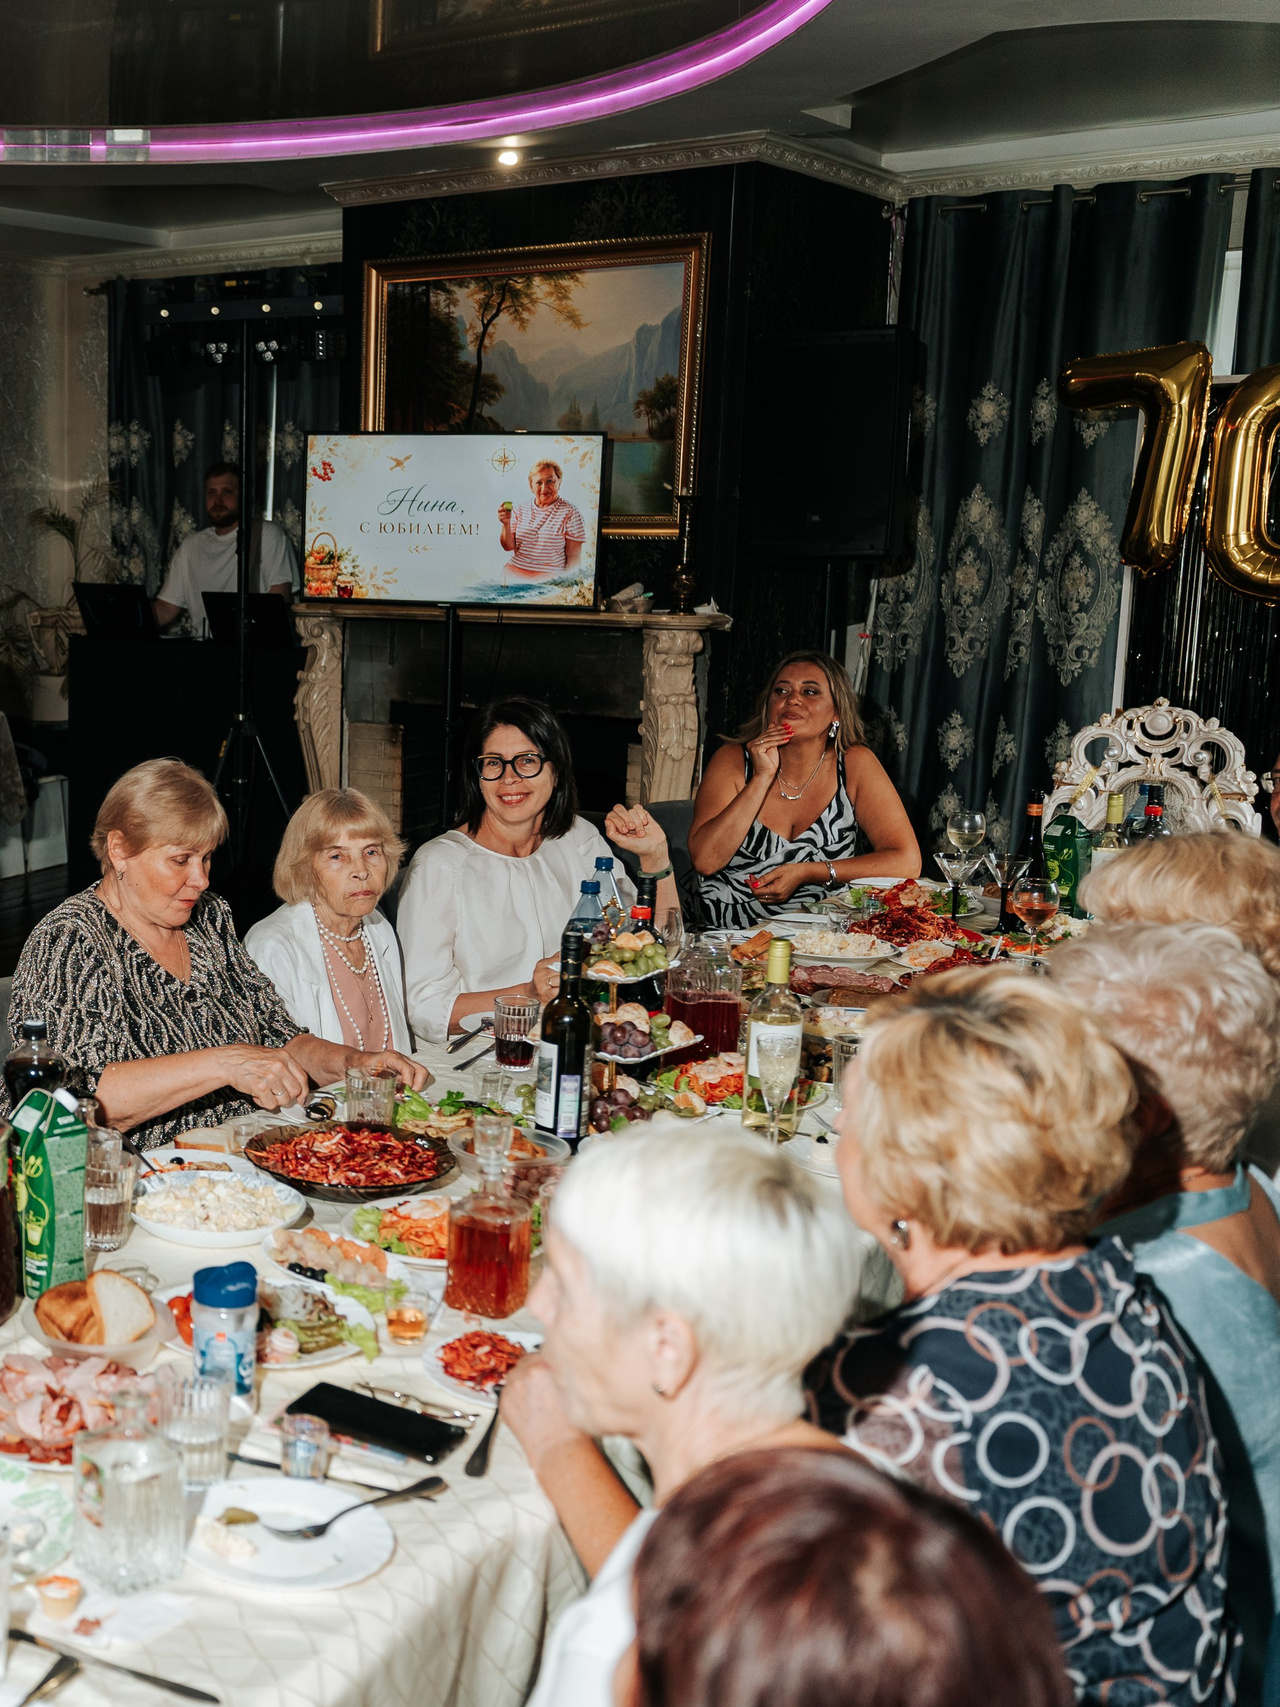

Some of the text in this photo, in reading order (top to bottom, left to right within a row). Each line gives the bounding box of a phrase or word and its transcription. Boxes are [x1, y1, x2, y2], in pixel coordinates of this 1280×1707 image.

[376, 484, 465, 517] Нина,
[359, 521, 480, 536] С ЮБИЛЕЕМ!
